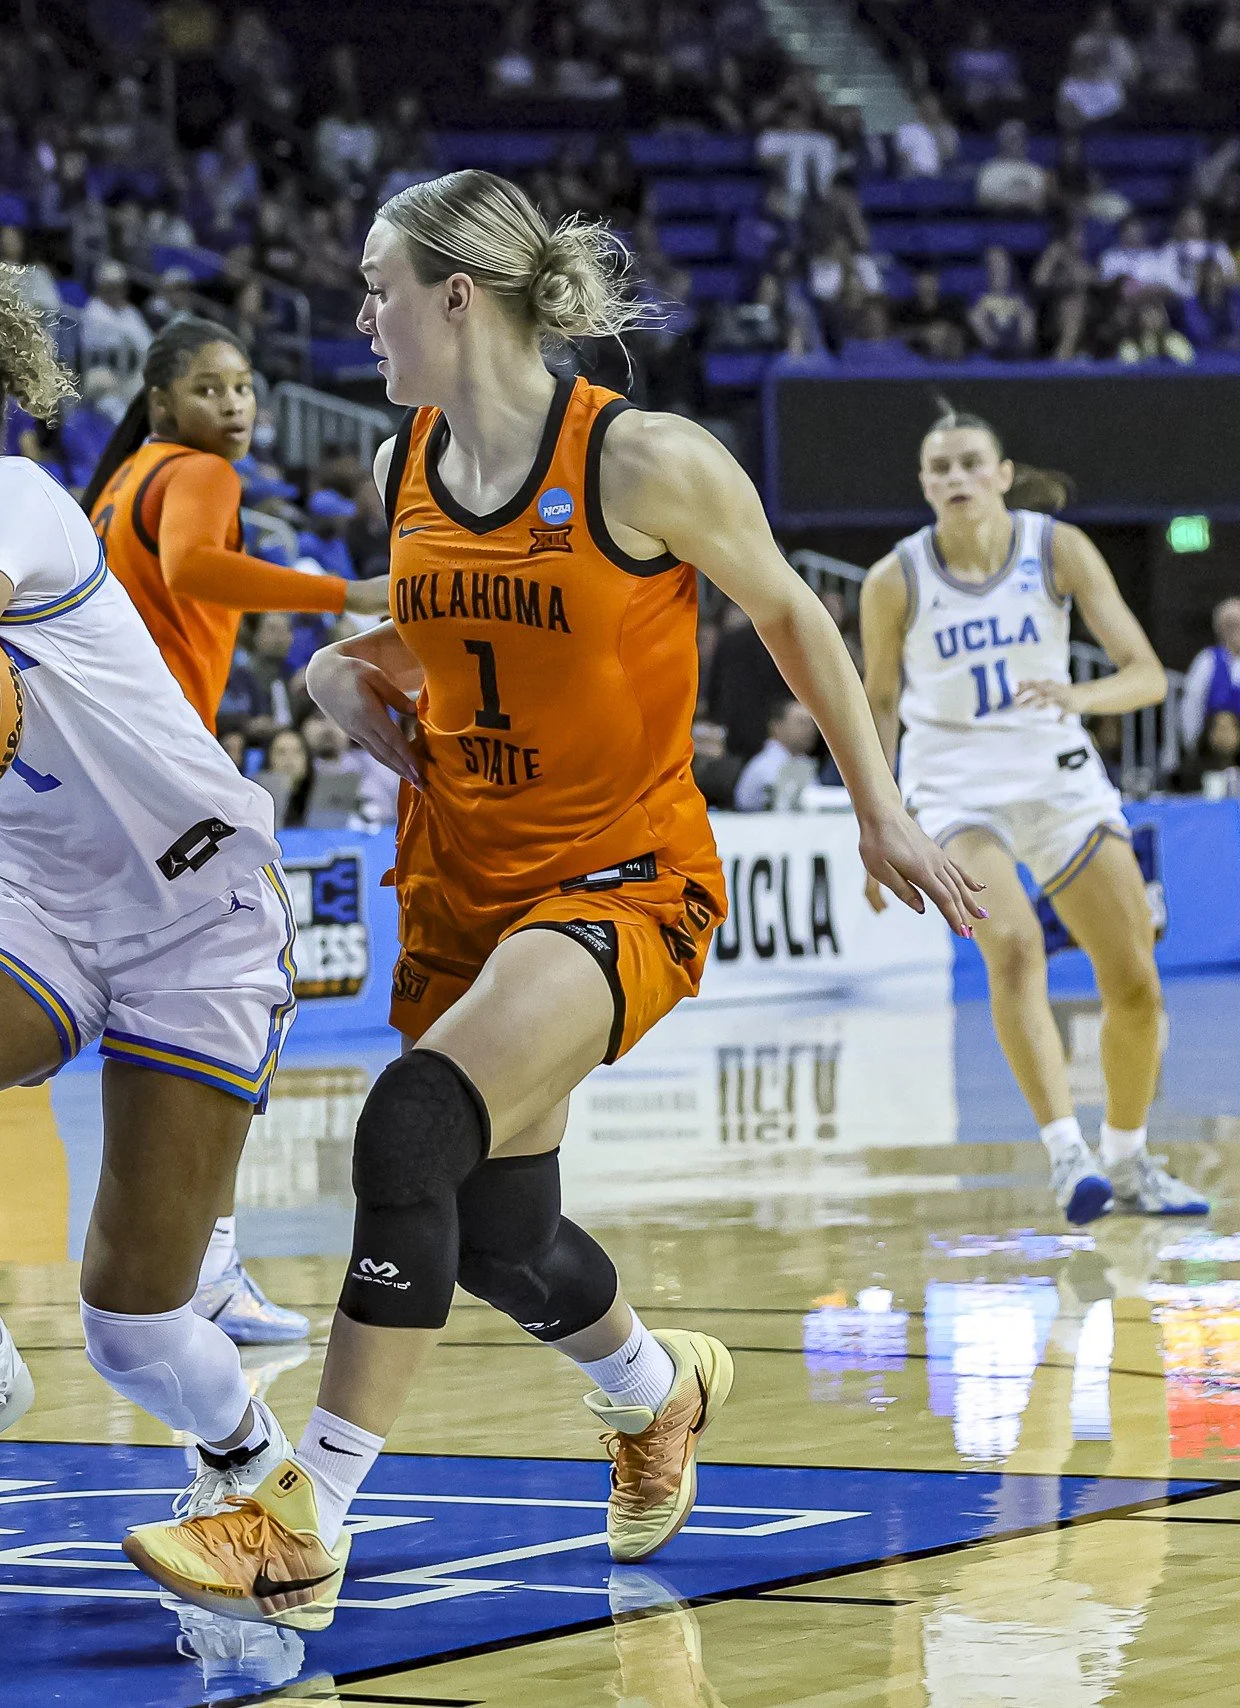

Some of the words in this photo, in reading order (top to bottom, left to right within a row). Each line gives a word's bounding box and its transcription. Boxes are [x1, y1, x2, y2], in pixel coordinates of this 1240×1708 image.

[543, 503, 571, 518] NCAA
[395, 571, 572, 634] OKLAHOMA
[934, 614, 1041, 660] UCLA
[461, 639, 511, 731] 1
[970, 659, 1015, 718] 11
[457, 735, 543, 786] STATE
[625, 861, 642, 872] 44
[716, 855, 841, 961] UCLA
